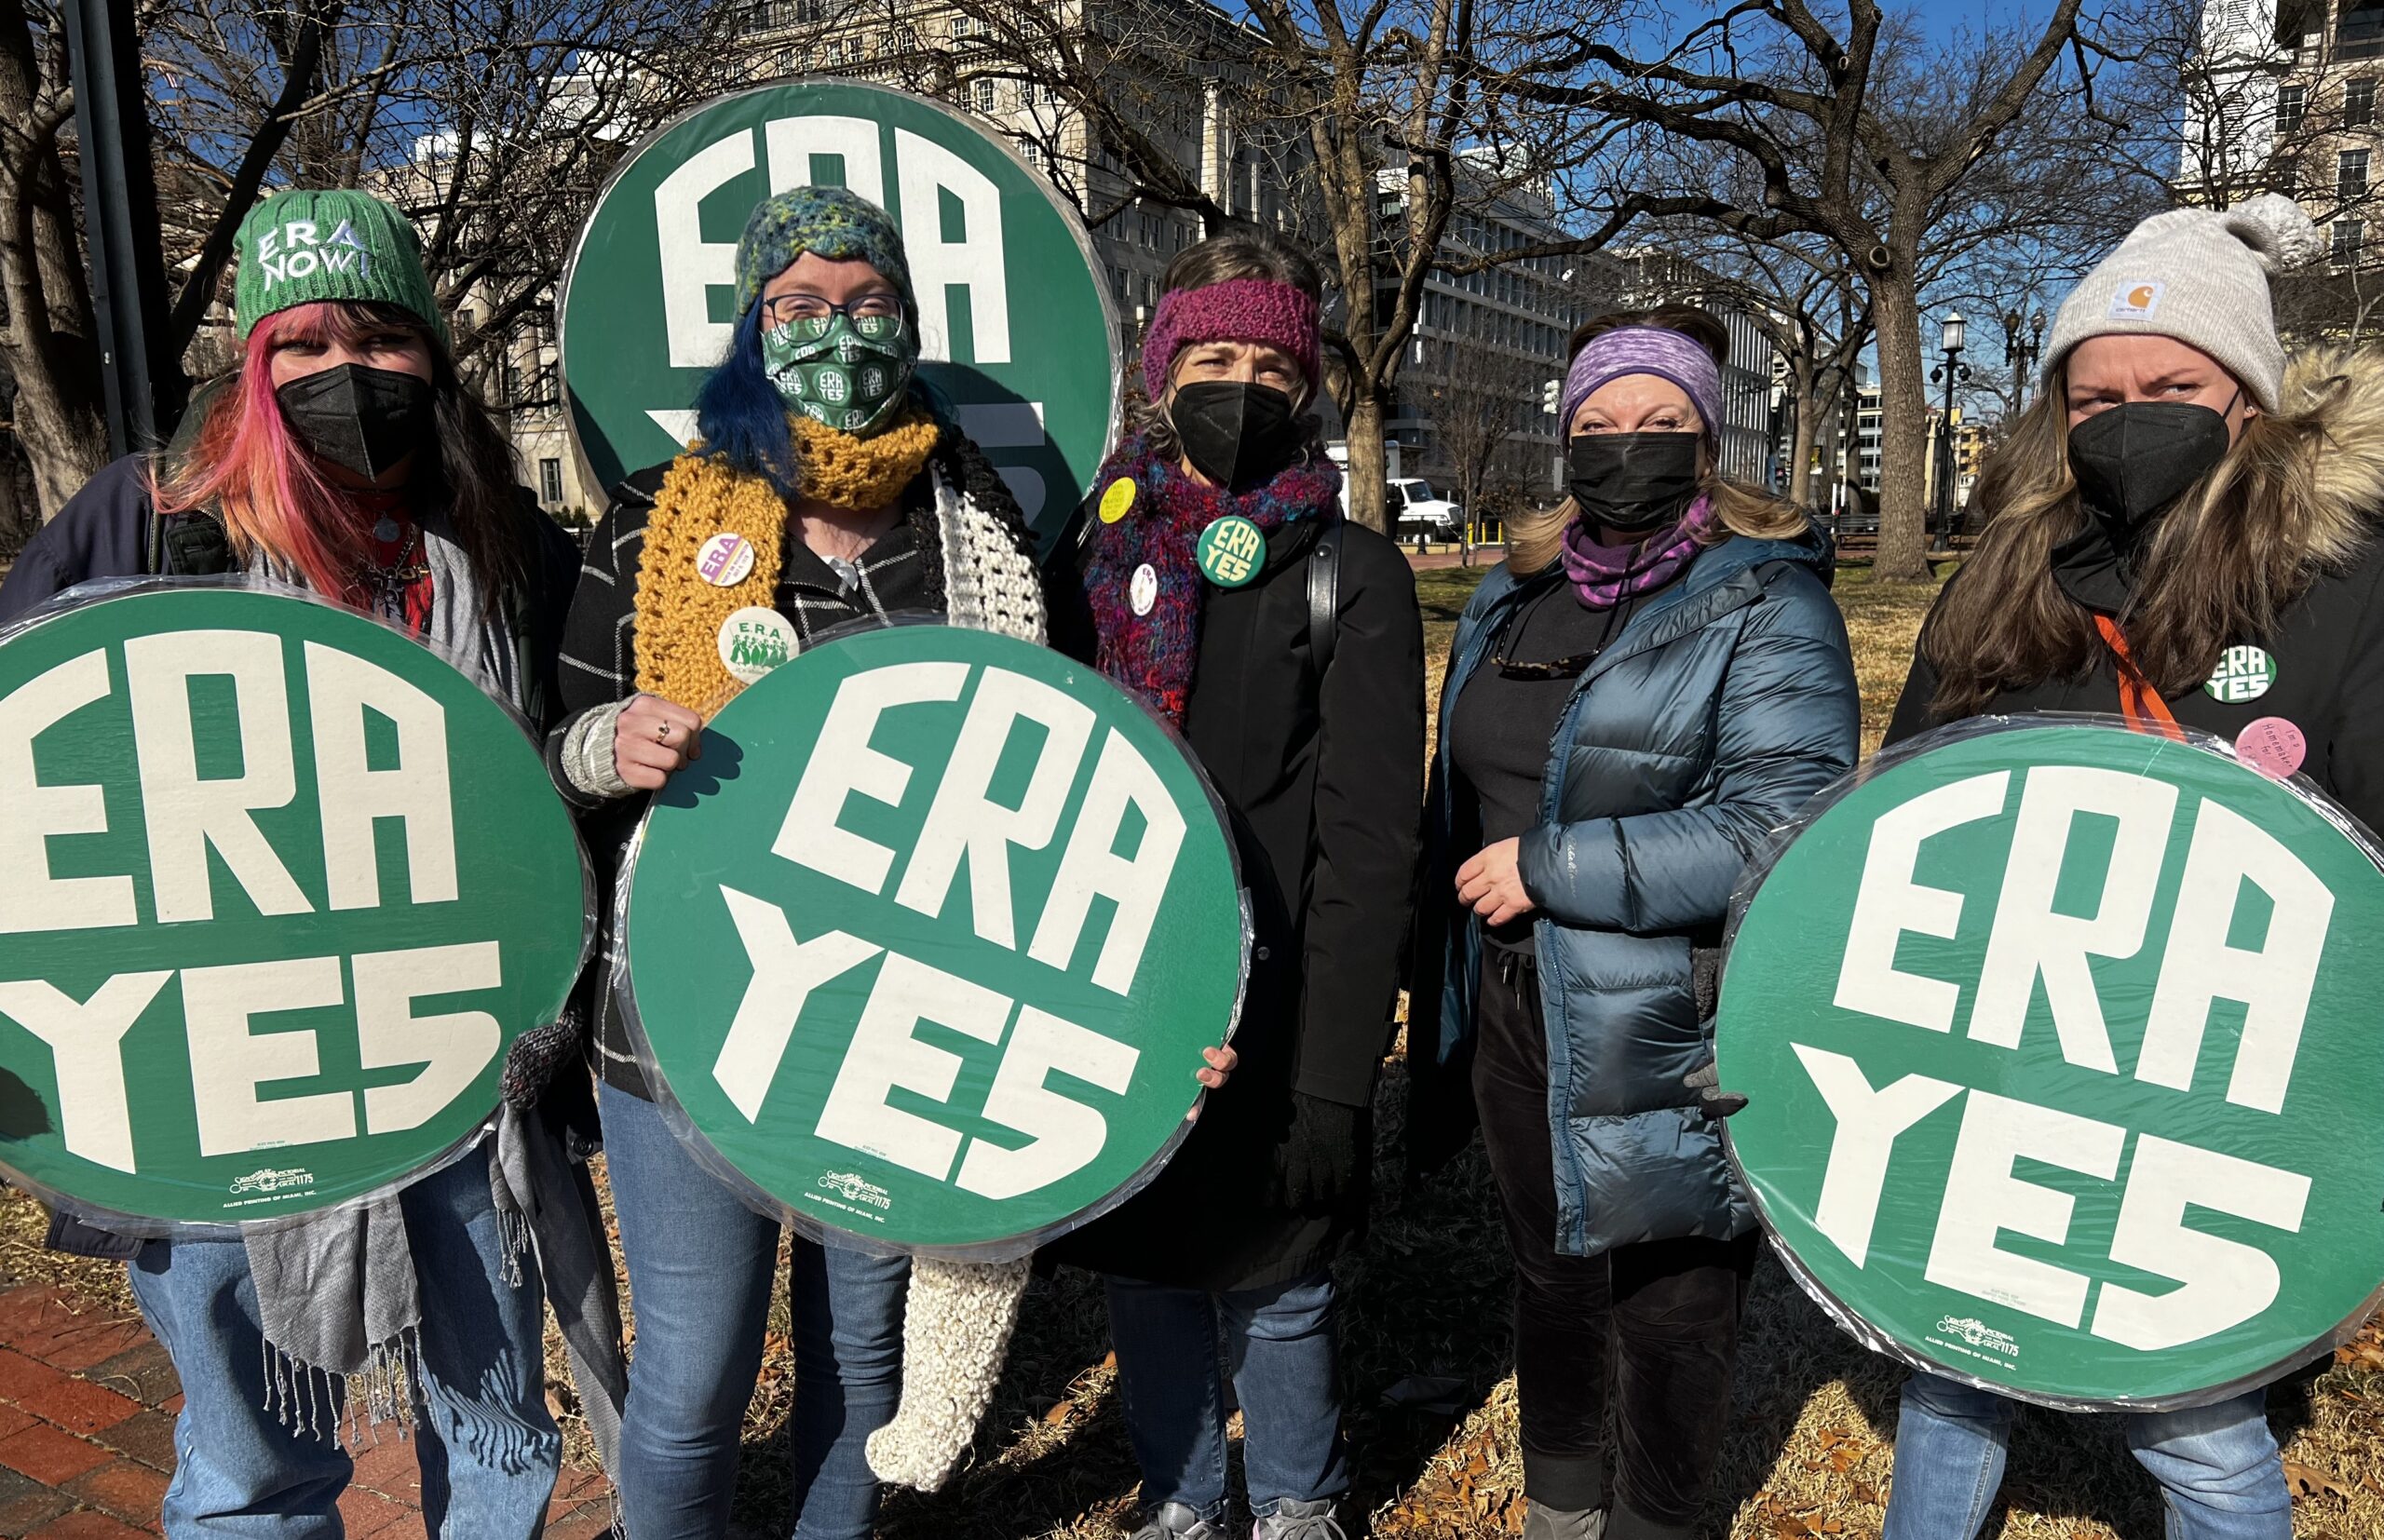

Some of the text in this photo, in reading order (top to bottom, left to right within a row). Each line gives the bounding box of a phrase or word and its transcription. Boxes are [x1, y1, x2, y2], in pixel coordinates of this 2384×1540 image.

[258, 219, 369, 263] ERA
[261, 248, 370, 291] NOW!
[819, 386, 844, 401] YES
[820, 371, 844, 388] ERA
[862, 368, 882, 385] ERA
[862, 383, 883, 397] YES
[700, 537, 738, 579] ERA
[1213, 520, 1260, 561] ERA
[1205, 544, 1252, 582] YES
[2212, 644, 2266, 678] ERA
[2206, 673, 2269, 700] YES
[0, 629, 458, 933] ERA
[773, 662, 1187, 996] ERA
[1834, 765, 2336, 1114] ERA
[0, 940, 502, 1175] YES
[712, 884, 1140, 1199] YES
[295, 1173, 313, 1185] 1175
[1790, 1042, 2311, 1351] YES
[244, 1196, 271, 1206] PRINTING
[282, 1192, 303, 1200] MIAMI,
[804, 1192, 821, 1202] ALLIED
[822, 1197, 847, 1210] PRINTING
[874, 1215, 886, 1223] INC.
[874, 1196, 891, 1210] 1175
[1924, 1335, 1944, 1346] ALLIED
[1944, 1342, 1971, 1356] PRINTING
[1982, 1355, 2002, 1367] MIAMI,
[2003, 1362, 2017, 1371] INC.
[2000, 1341, 2019, 1358] 1175
